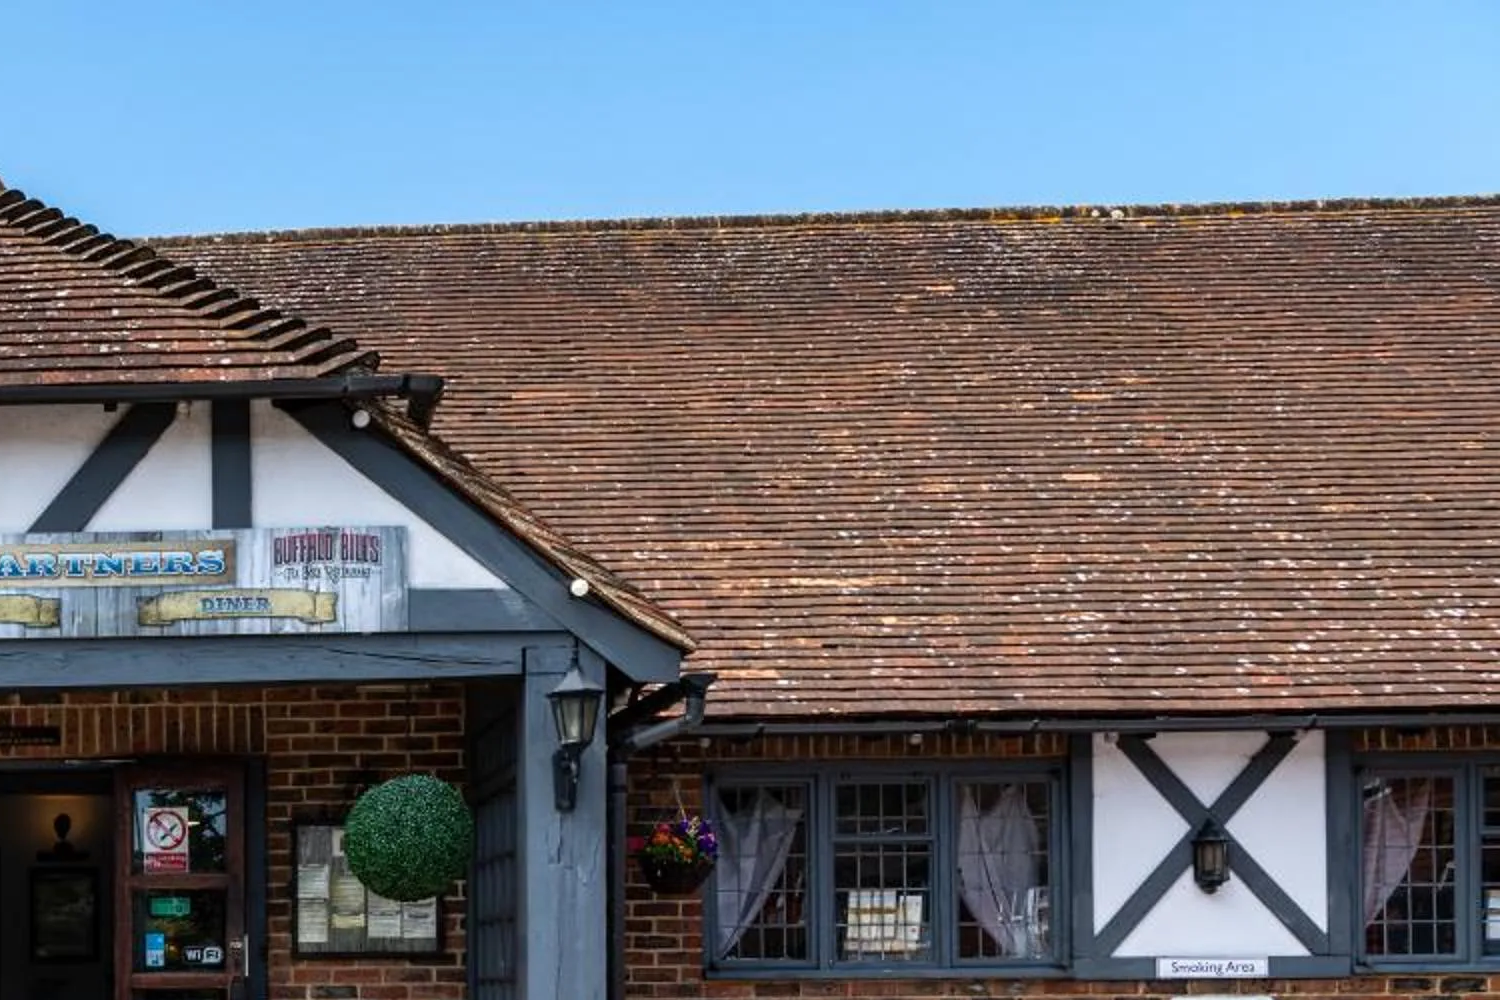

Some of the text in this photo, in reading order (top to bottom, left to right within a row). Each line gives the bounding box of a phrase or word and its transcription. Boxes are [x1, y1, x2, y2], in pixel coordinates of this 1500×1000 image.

[274, 533, 332, 565] BUFFALO
[200, 596, 271, 613] DINER
[1171, 961, 1256, 976] Smoking Area
